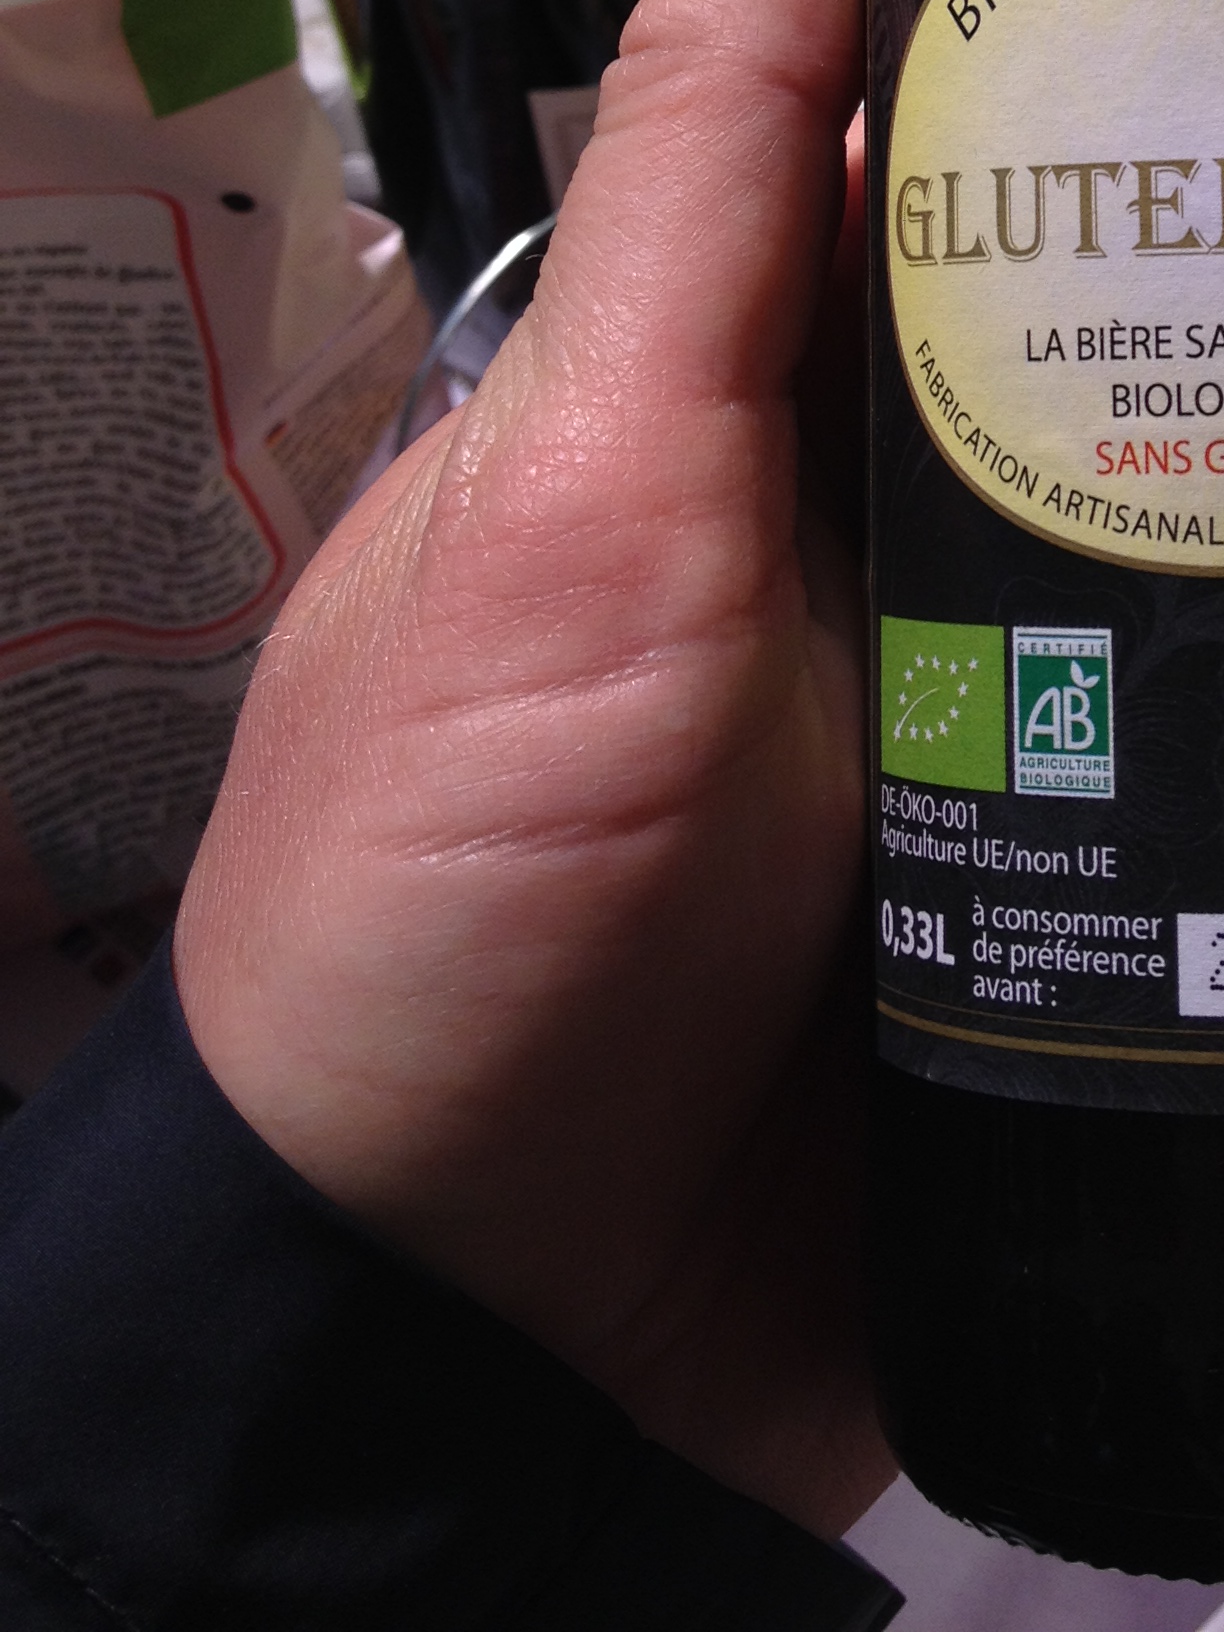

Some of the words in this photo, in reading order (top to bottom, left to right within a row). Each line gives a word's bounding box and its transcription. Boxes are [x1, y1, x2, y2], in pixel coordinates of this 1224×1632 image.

[1025, 326, 1066, 364] LA
[1076, 318, 1175, 362] BIÈRE
[912, 337, 1040, 501] FABRICATION
[1095, 439, 1192, 476] SANS
[1017, 640, 1108, 655] CERTIFIÉ
[1024, 685, 1097, 751] AB
[1019, 756, 1111, 772] AGRICULTURE
[1019, 772, 1112, 789] BIOLOGIQUE
[881, 783, 978, 831] DE-ÖKO-001
[881, 818, 967, 866] Agriculture
[973, 837, 1069, 875] UE/non
[1078, 846, 1118, 879] UE
[881, 898, 956, 966] 0,33L
[972, 894, 985, 927] à
[991, 905, 1163, 941] consommer
[972, 931, 1003, 965] de
[1009, 939, 1166, 977] préférence
[972, 973, 1043, 1006] avant
